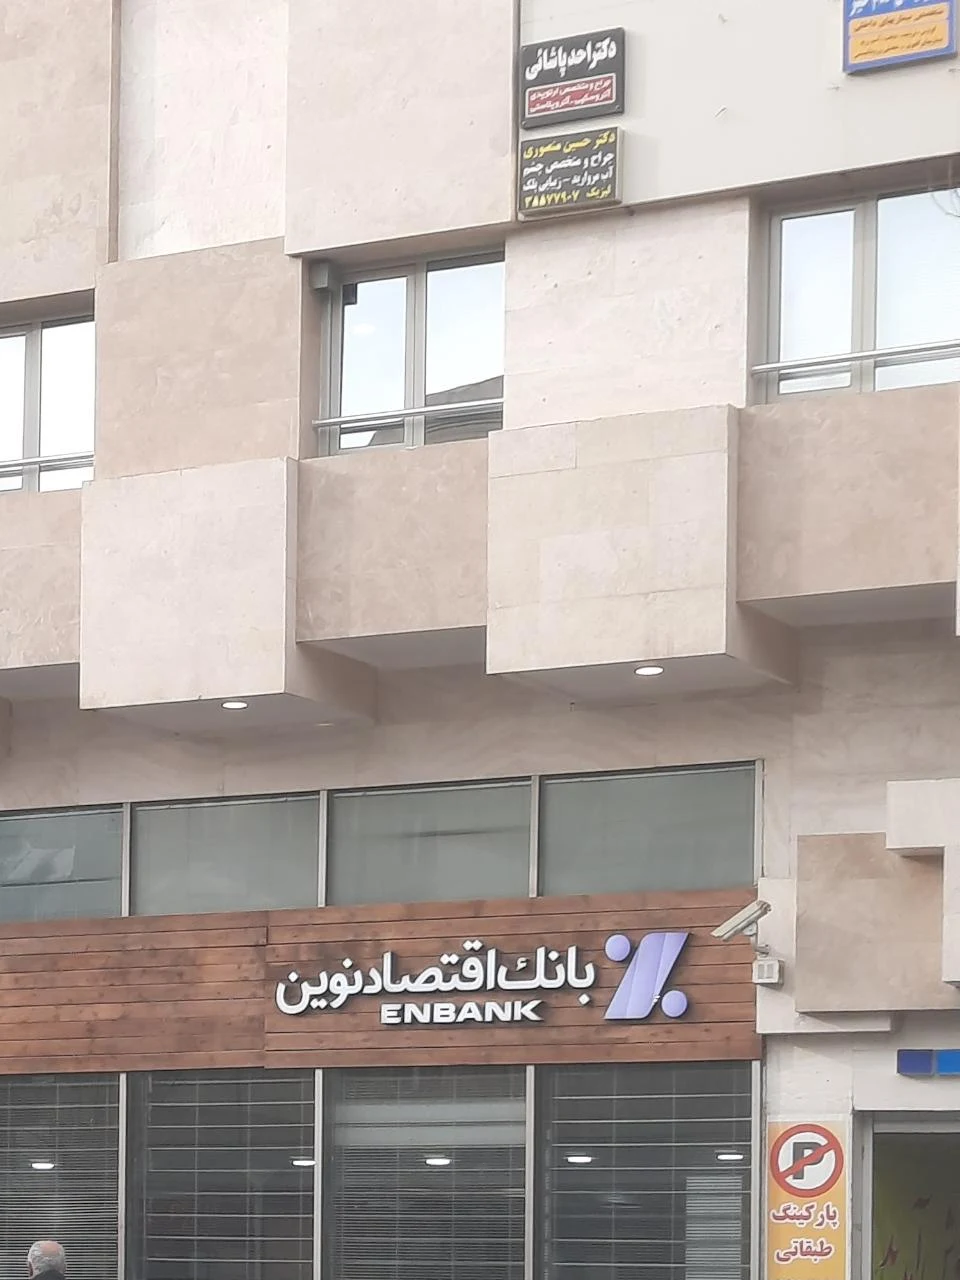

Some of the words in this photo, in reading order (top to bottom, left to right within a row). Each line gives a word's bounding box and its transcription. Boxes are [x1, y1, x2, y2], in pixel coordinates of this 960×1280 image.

[567, 40, 593, 68] احد
[588, 36, 617, 71] دکتر
[563, 137, 592, 154] حسین
[592, 130, 616, 150] دکتر
[523, 140, 562, 160] منصوری
[590, 150, 615, 168] جراح
[523, 161, 544, 178] چشم
[545, 155, 581, 174] متخصص
[582, 157, 589, 170] و
[571, 170, 600, 187] مروارید
[600, 165, 614, 183] آب
[585, 183, 612, 199] لیزیک
[379, 999, 544, 1025] ENBANK
[771, 1203, 838, 1228] پارکینگ
[775, 1239, 833, 1263] طبقاتی
